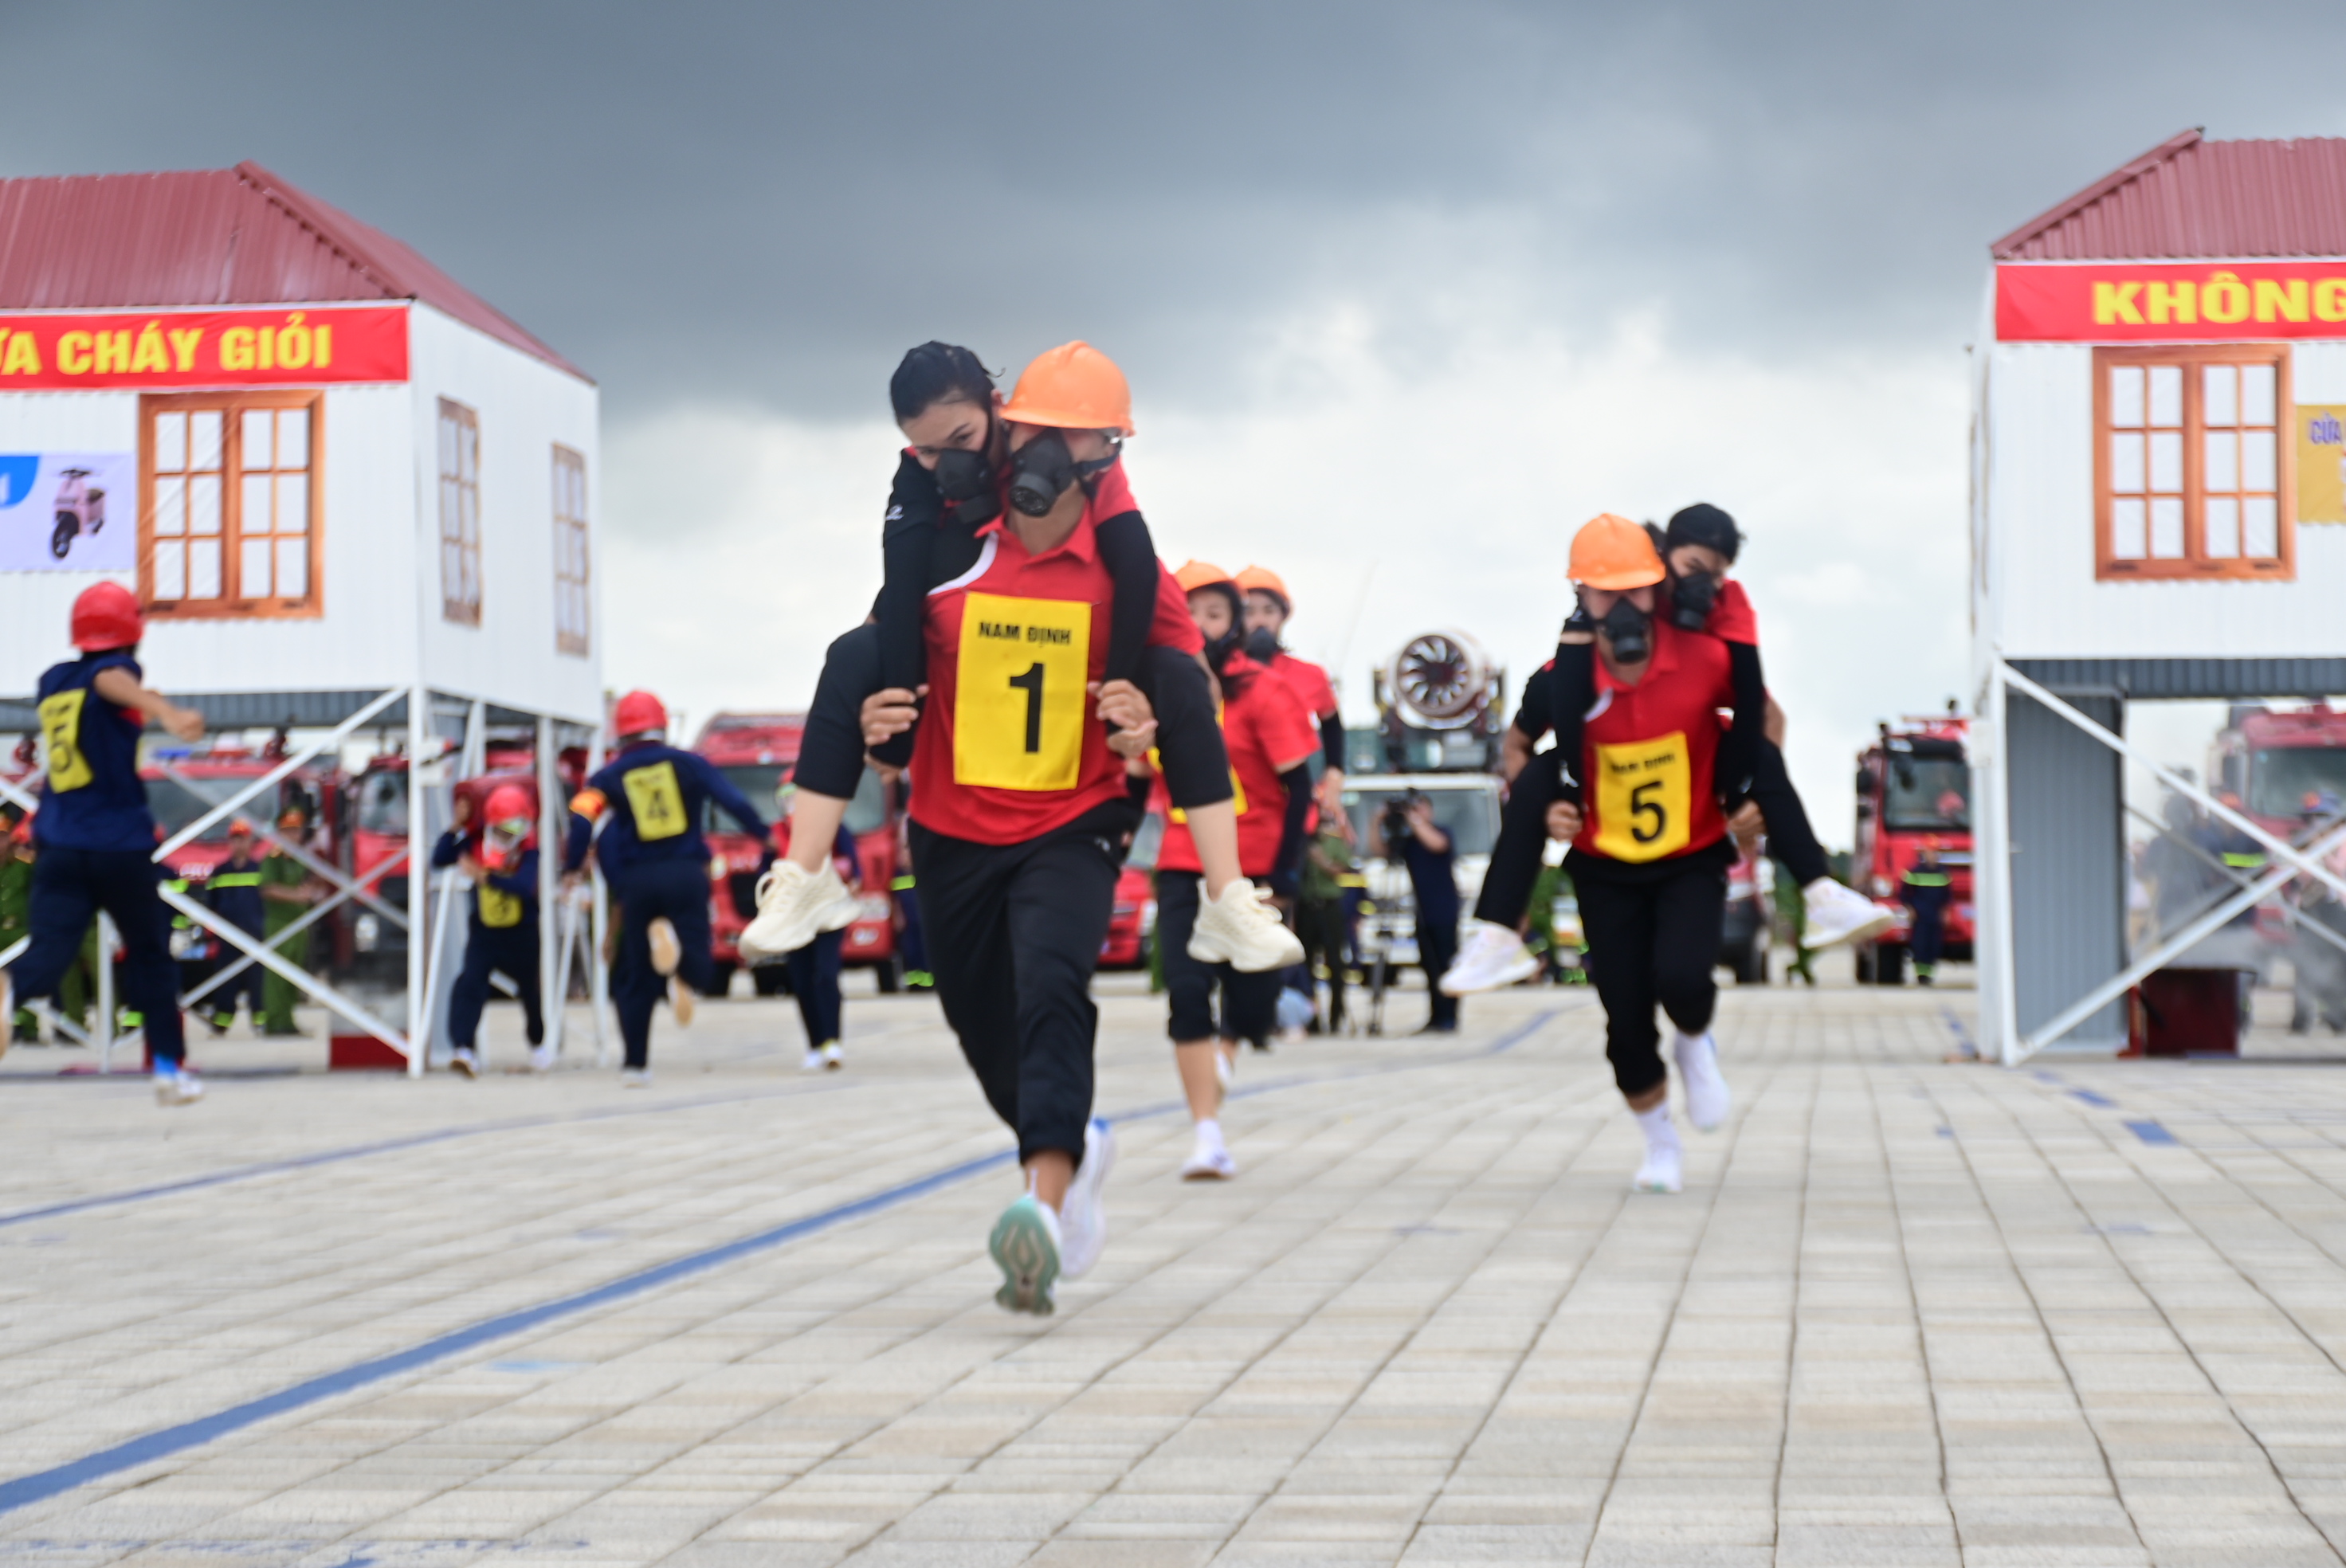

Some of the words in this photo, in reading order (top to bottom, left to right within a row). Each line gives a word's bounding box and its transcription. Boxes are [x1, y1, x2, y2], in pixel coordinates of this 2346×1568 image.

[57, 319, 204, 375] CHÁY
[219, 312, 332, 371] GIỎI
[979, 622, 1019, 640] NAM
[1028, 627, 1070, 648] ĐỊNH
[1009, 662, 1044, 754] 1
[1631, 780, 1665, 842] 5
